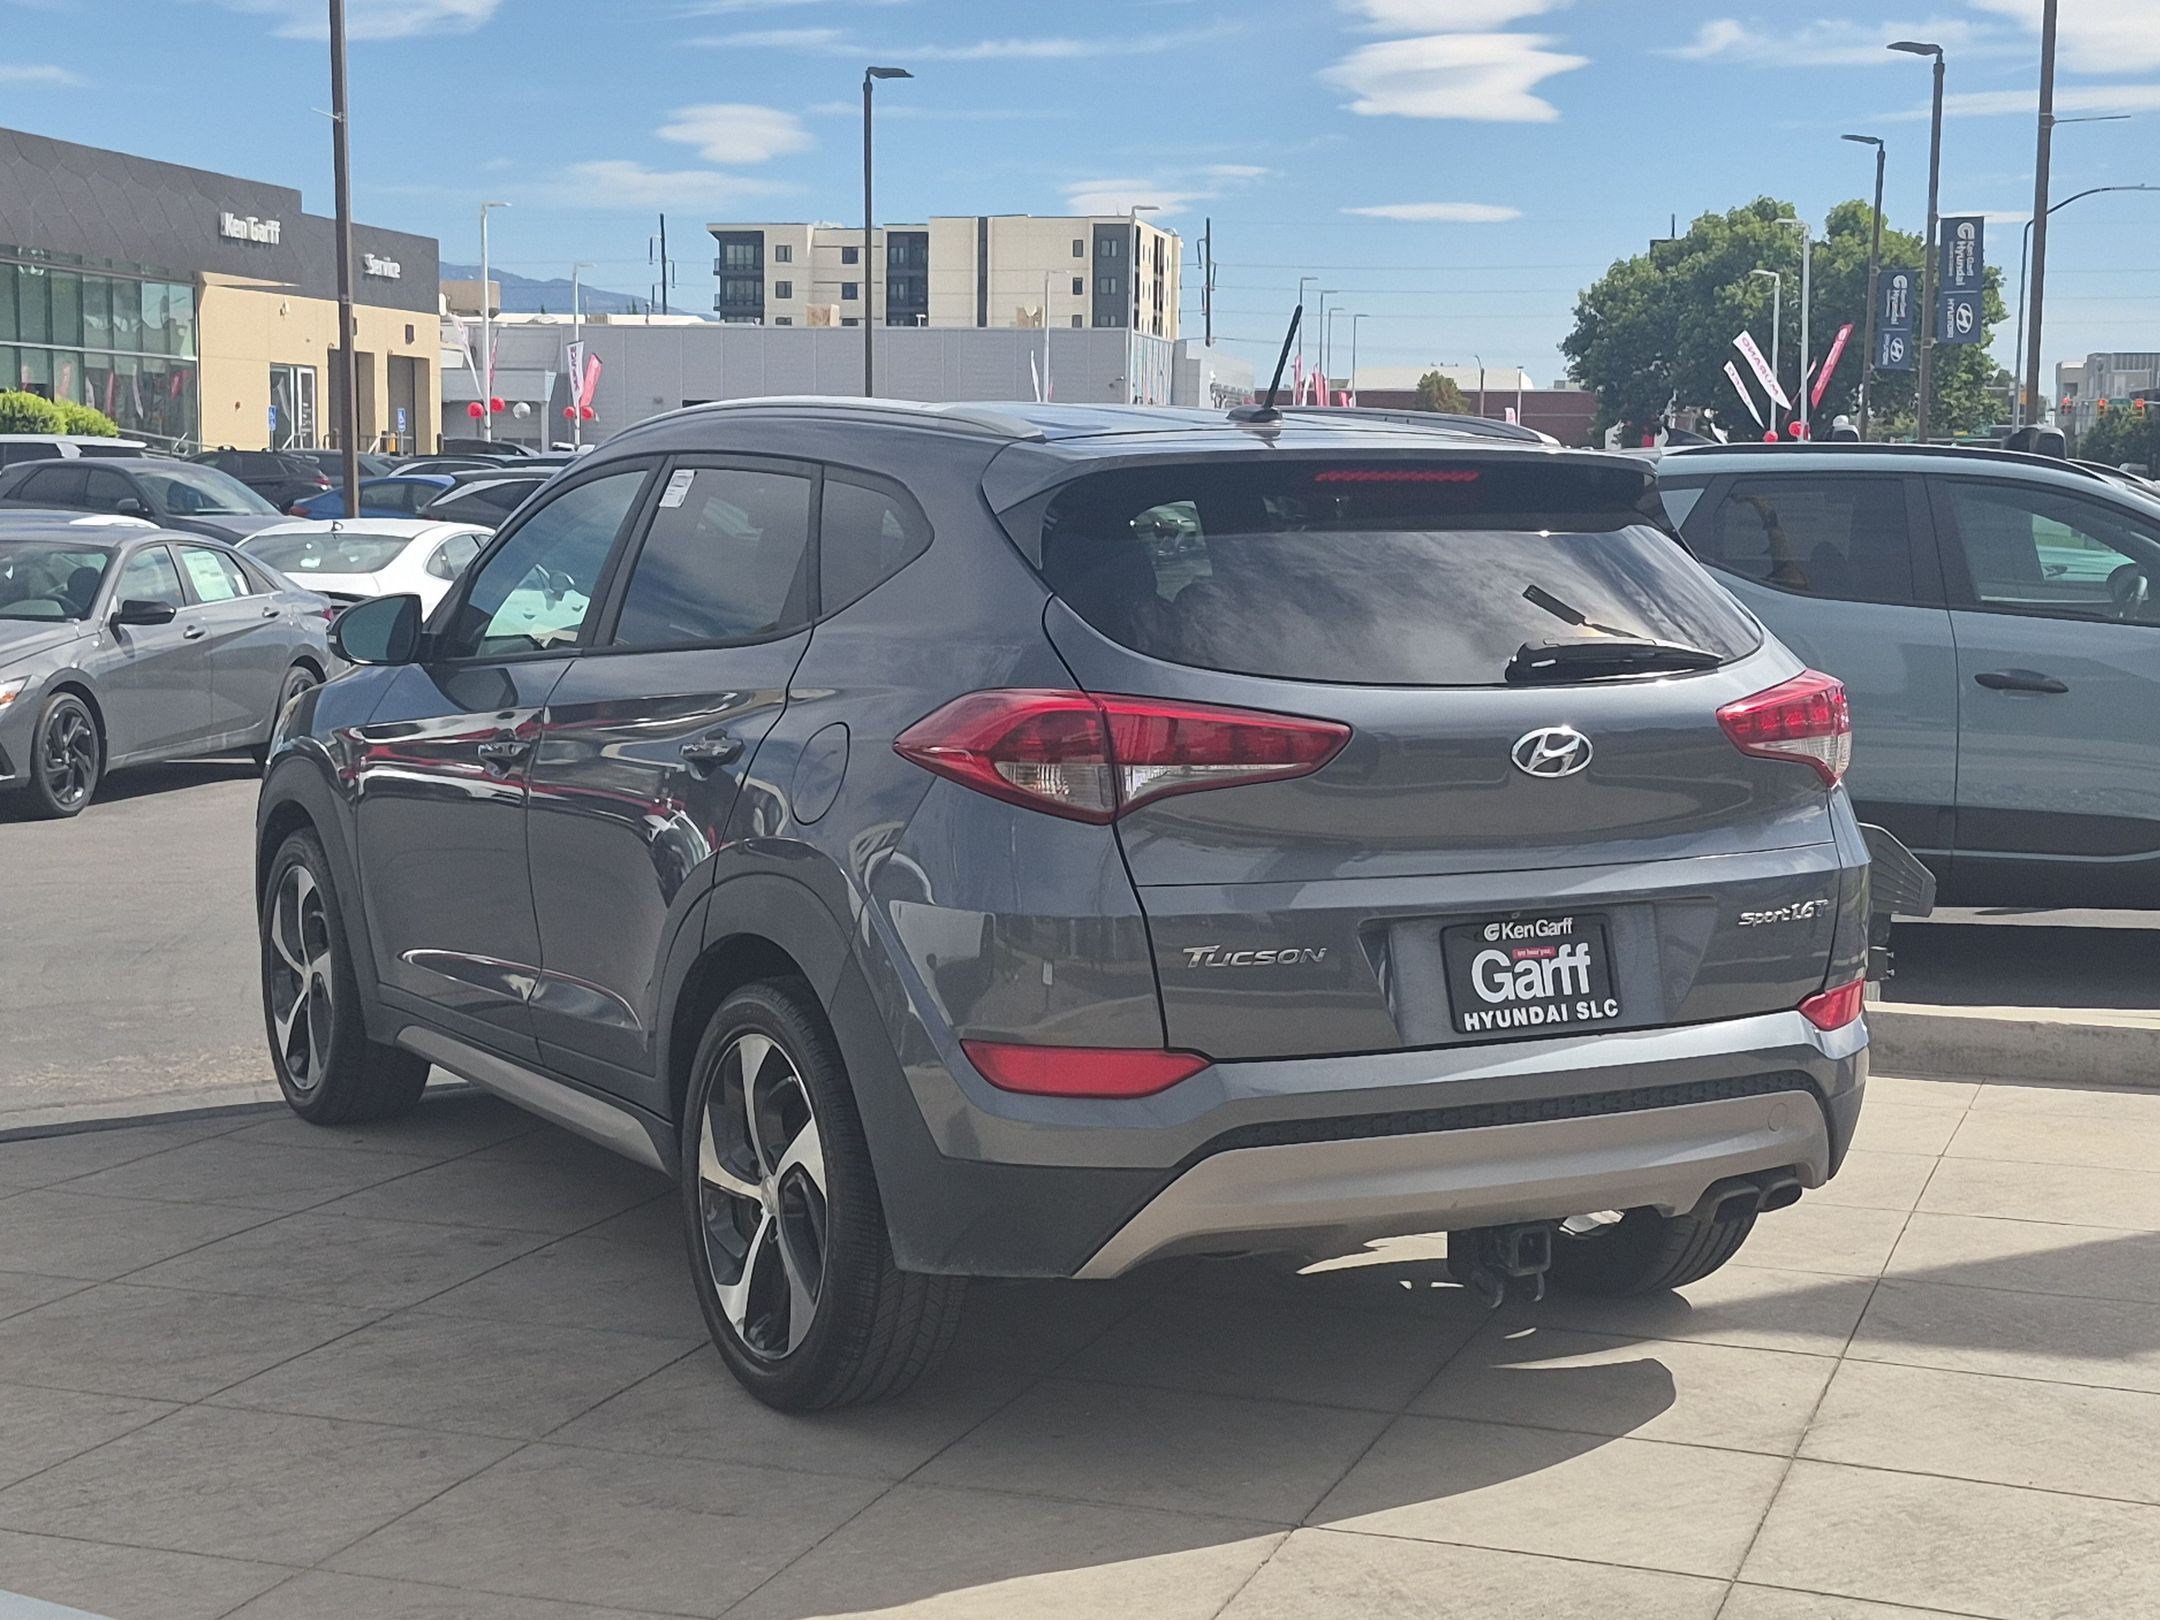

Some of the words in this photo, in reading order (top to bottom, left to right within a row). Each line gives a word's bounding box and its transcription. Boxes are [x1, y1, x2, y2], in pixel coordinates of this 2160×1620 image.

[224, 212, 247, 239] Ken
[247, 216, 281, 245] Garff
[364, 253, 401, 279] Service
[1954, 241, 1966, 286] Hyundai
[1501, 920, 1535, 941] Ken
[1535, 917, 1574, 938] Garff
[1183, 944, 1328, 968] TUCSON
[1471, 942, 1591, 1004] Garff
[1463, 1004, 1568, 1032] HYUNDAI
[1576, 998, 1619, 1020] SLC
